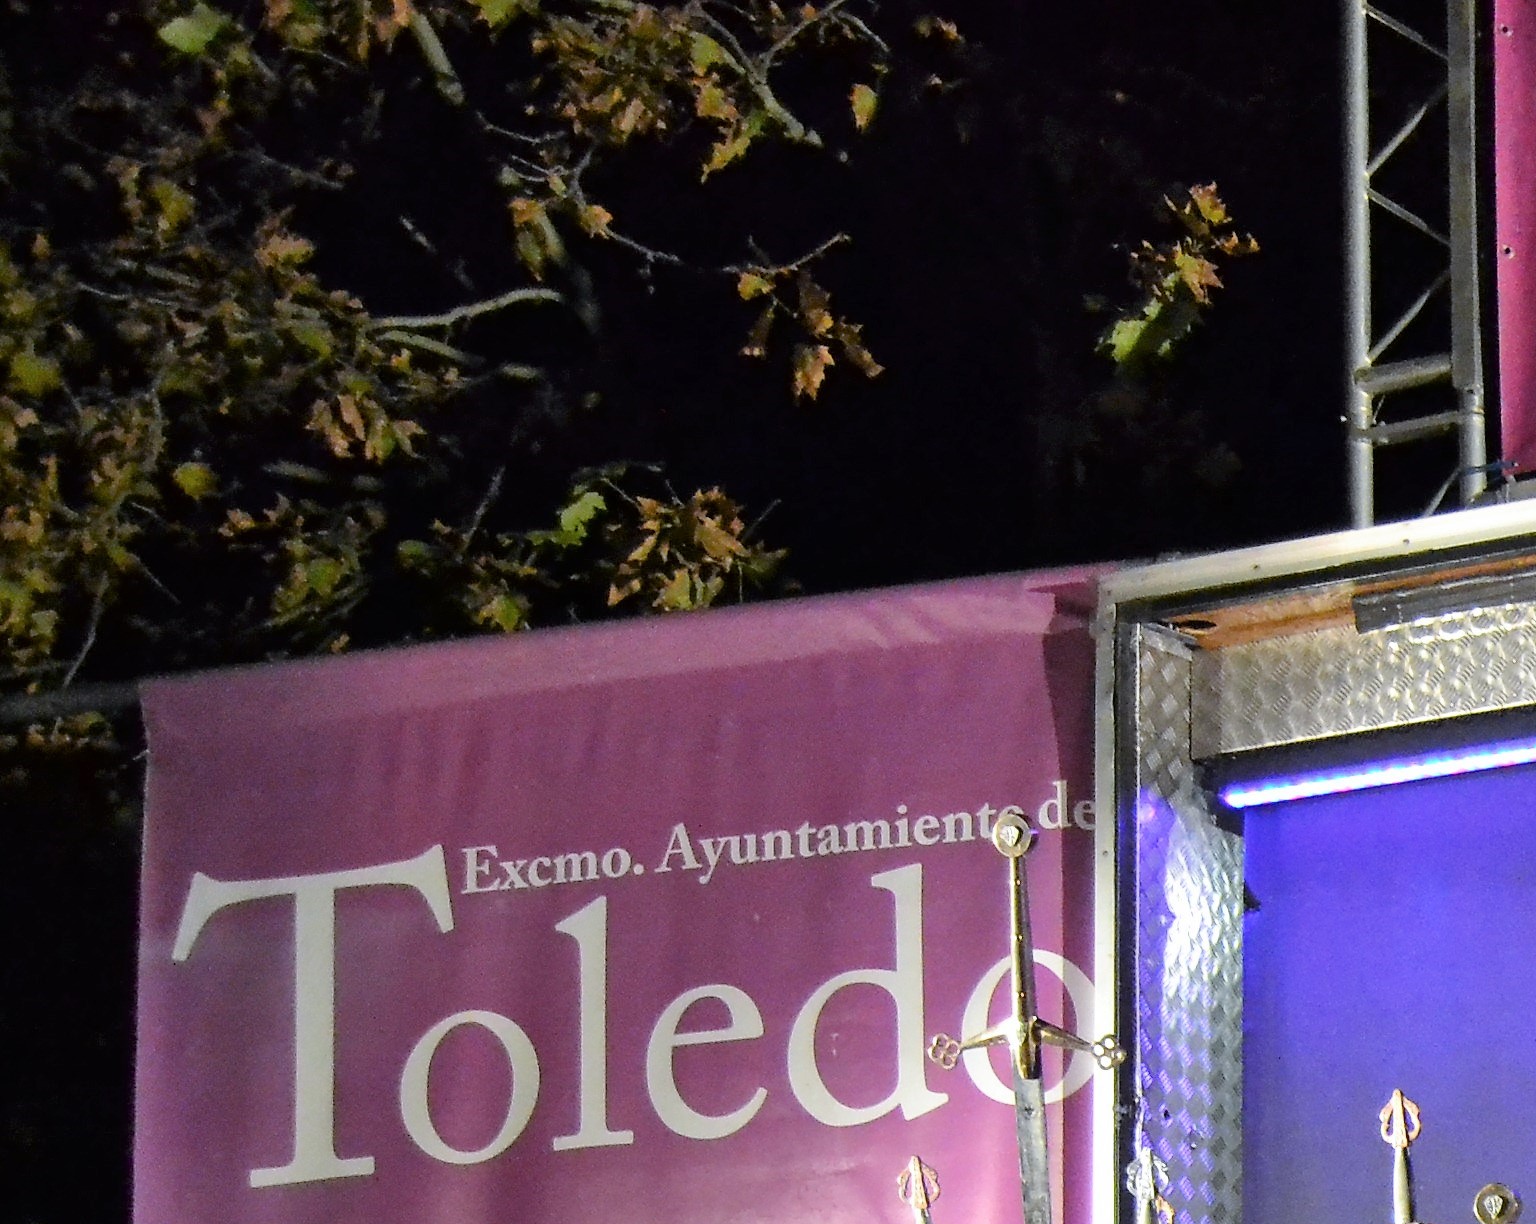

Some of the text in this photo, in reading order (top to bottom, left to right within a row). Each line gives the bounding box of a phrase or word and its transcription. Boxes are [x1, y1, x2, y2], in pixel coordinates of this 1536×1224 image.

[461, 844, 645, 895] Excmo.
[1038, 780, 1096, 831] de
[172, 843, 1096, 1189] Toledo
